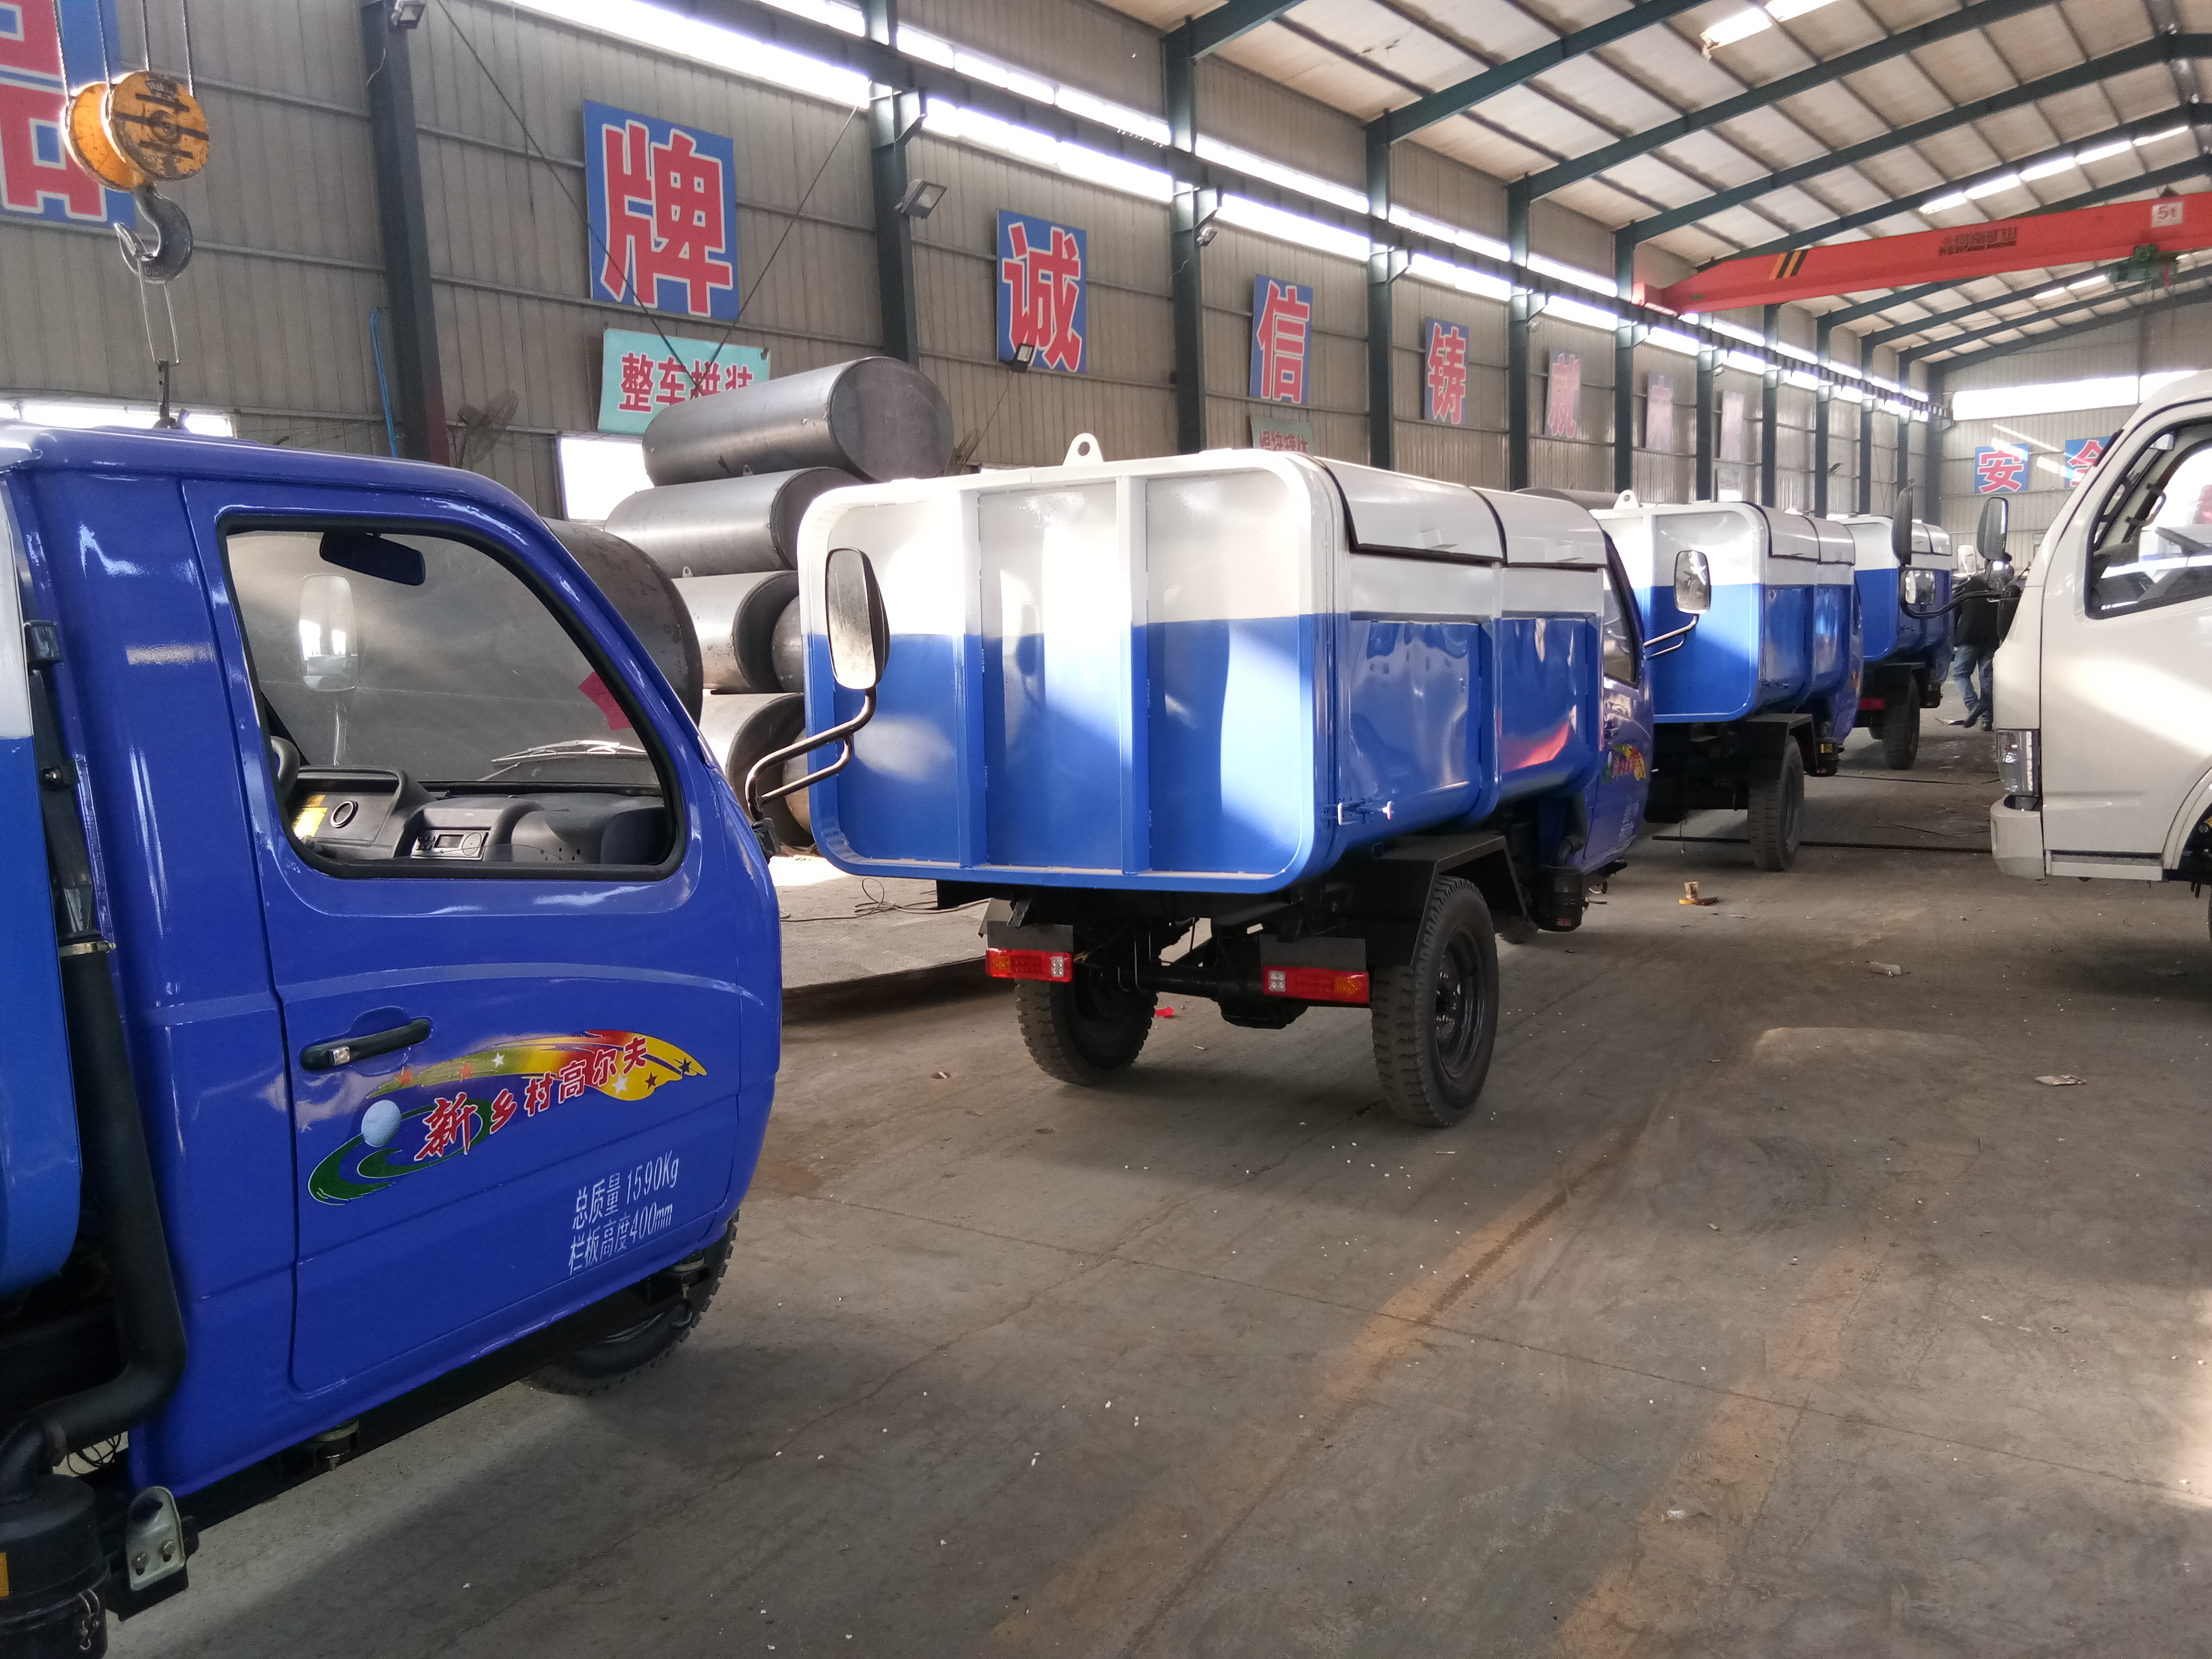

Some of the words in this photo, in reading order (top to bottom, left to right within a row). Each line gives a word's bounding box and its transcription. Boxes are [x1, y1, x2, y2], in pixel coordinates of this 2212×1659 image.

[601, 120, 733, 317] 牌
[1002, 222, 1081, 372] 诚
[1256, 280, 1310, 404] 信
[1428, 322, 1466, 424] 铸
[1978, 449, 2024, 494] 安
[414, 1036, 647, 1161] 新乡村高尔夫
[568, 1201, 673, 1276] 栏板高度400mm
[572, 1172, 621, 1230] 总质量
[626, 1150, 679, 1205] 1590Kg
